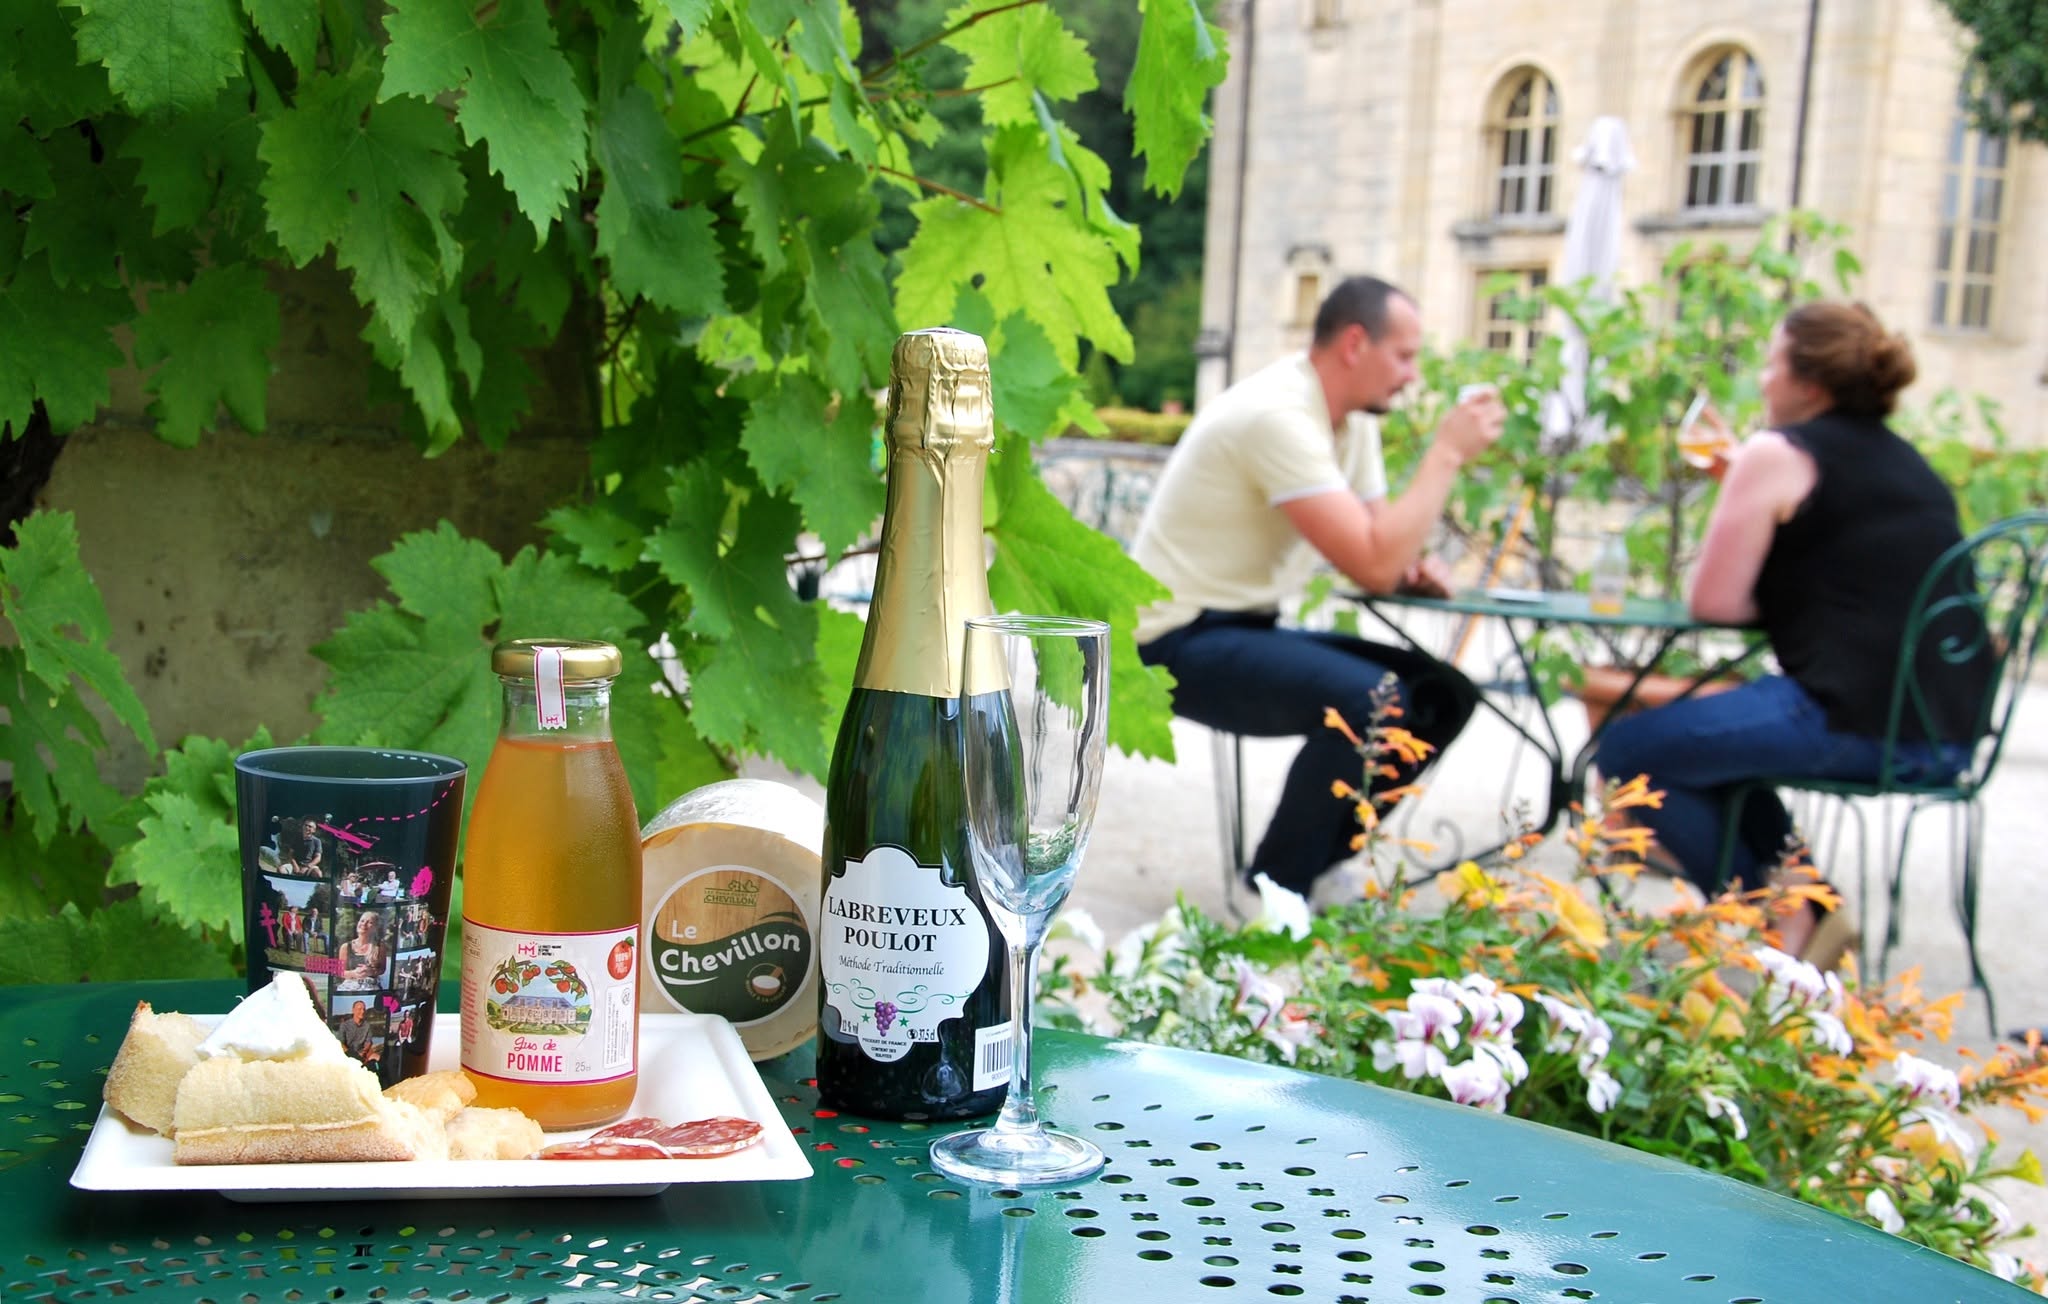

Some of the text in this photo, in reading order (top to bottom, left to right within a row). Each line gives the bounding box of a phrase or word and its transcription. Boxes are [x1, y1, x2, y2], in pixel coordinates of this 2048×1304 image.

[705, 894, 754, 905] CHEVILLON
[828, 895, 966, 927] LABREVEUX
[671, 919, 697, 939] Le
[844, 926, 937, 952] POULOT
[660, 931, 801, 974] Chevillon
[839, 955, 944, 976] Méthode Traditionnelle
[543, 1039, 557, 1051] de
[507, 1052, 563, 1073] POMME
